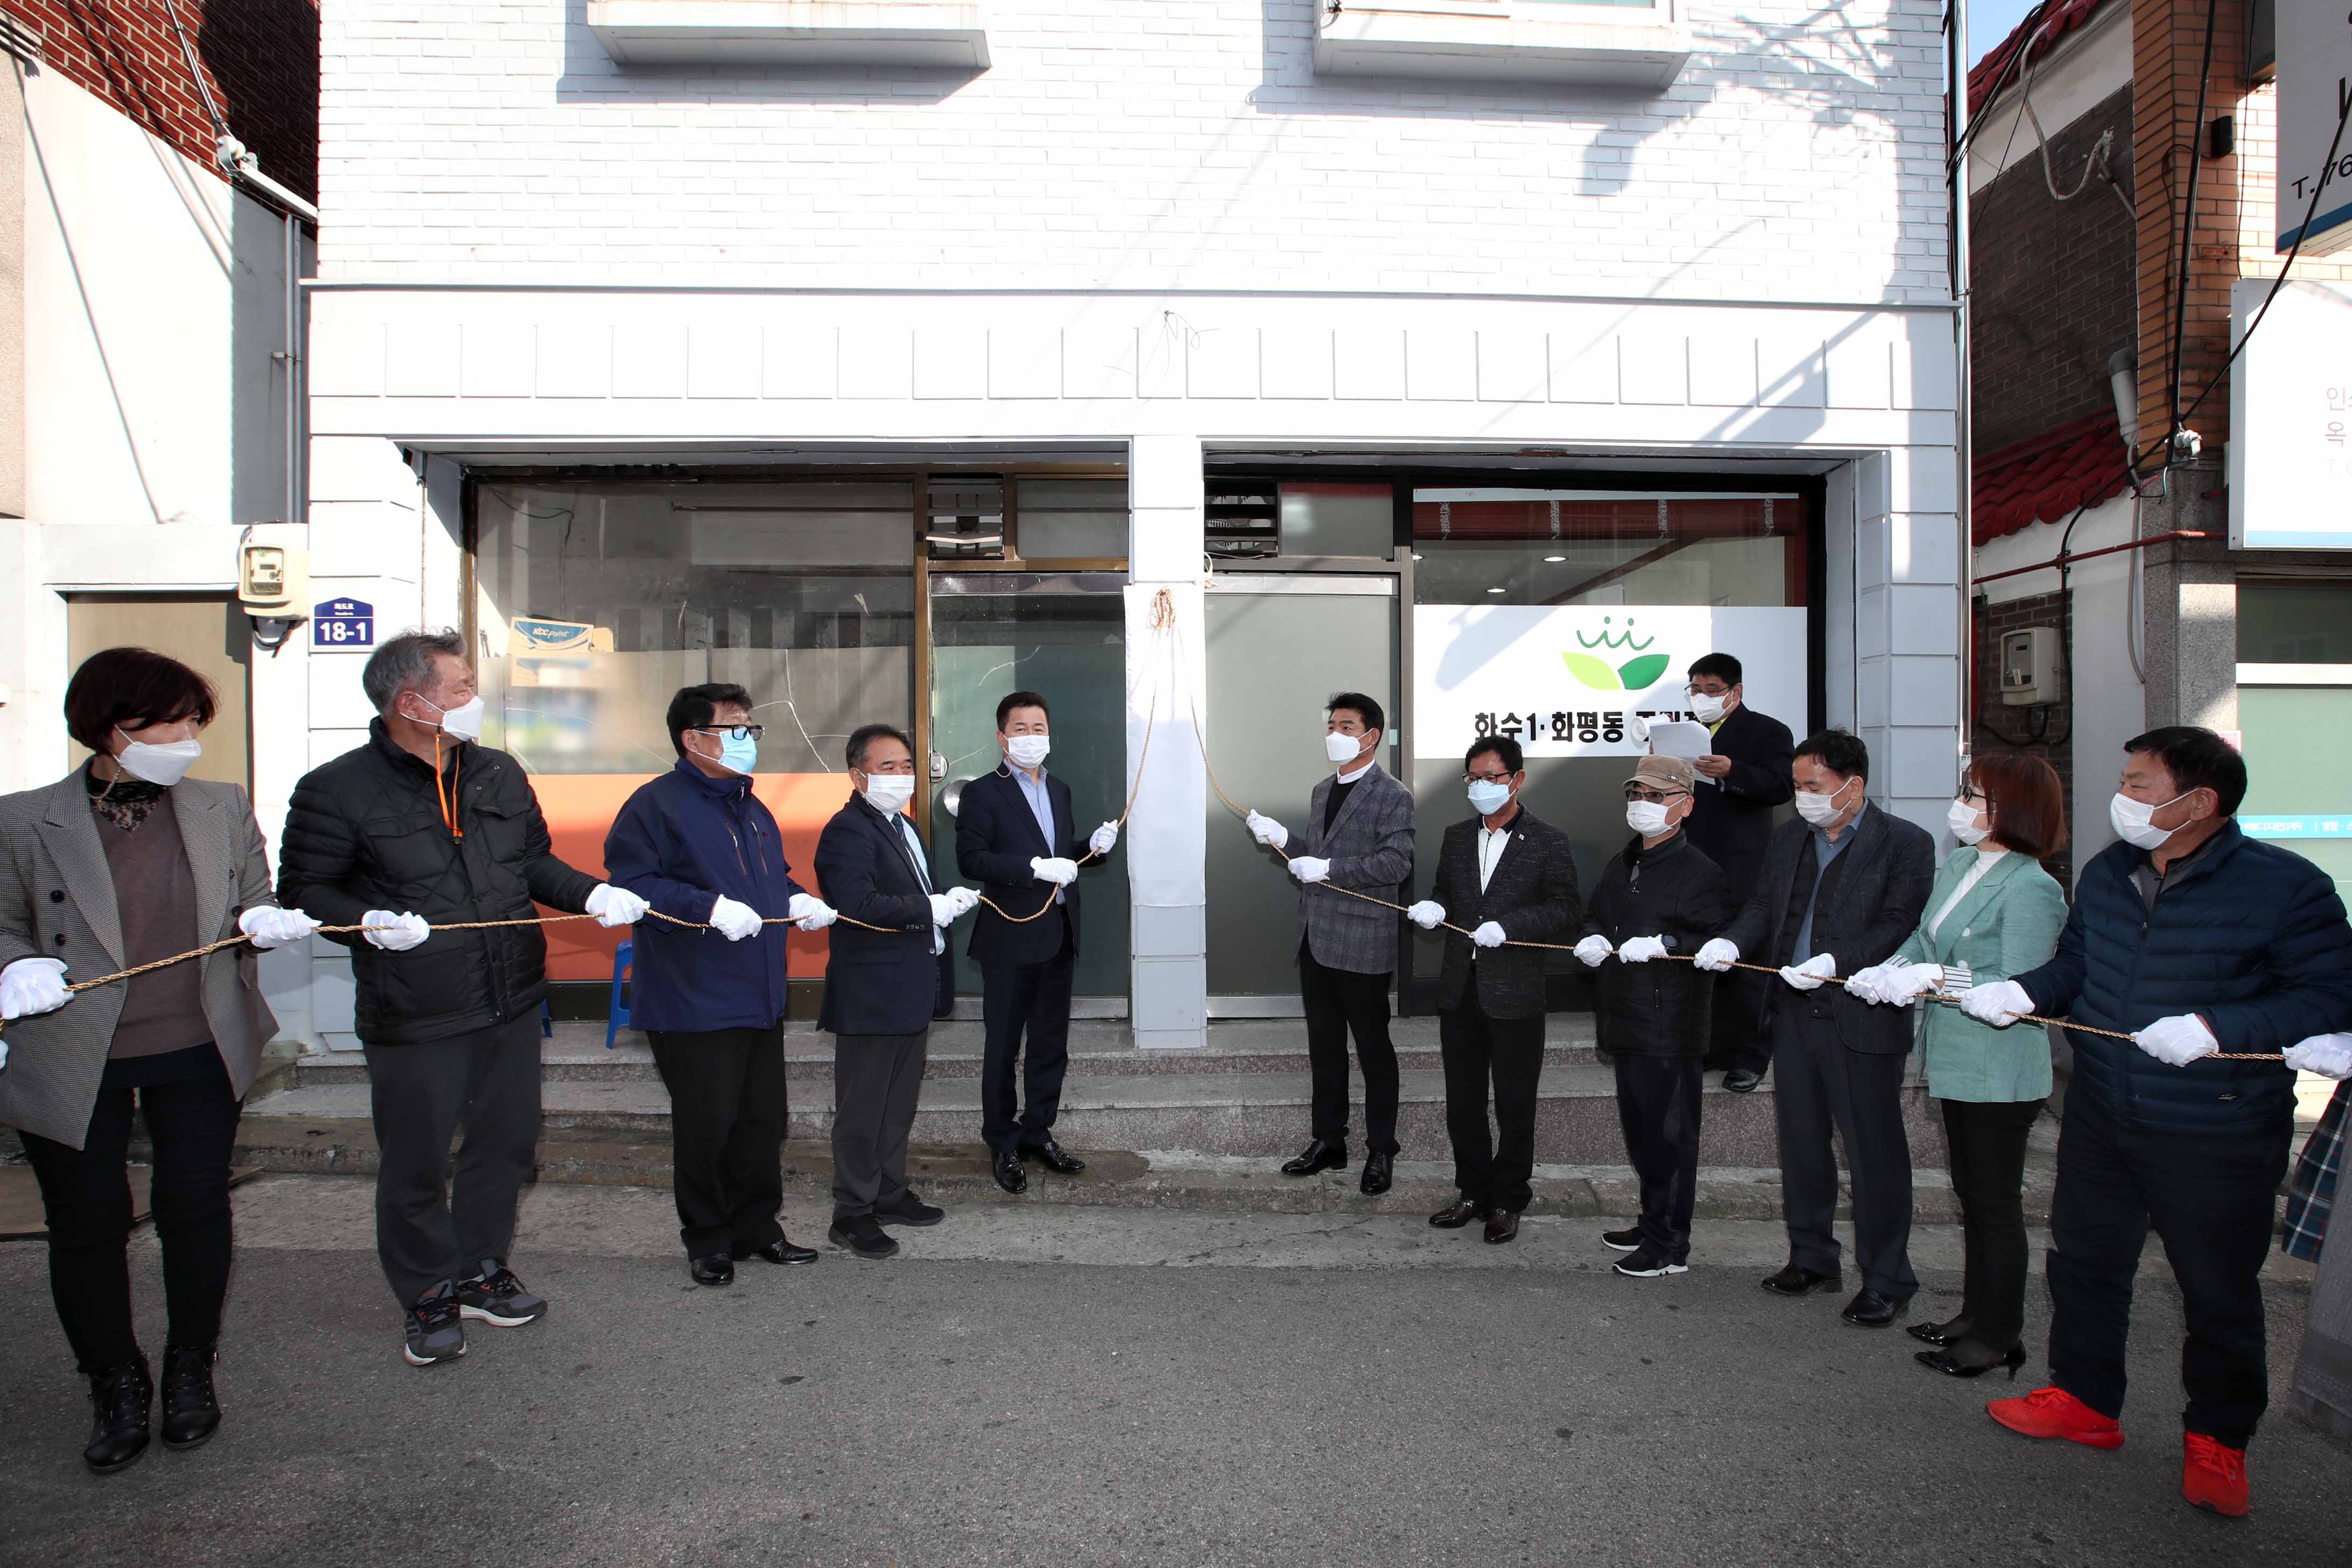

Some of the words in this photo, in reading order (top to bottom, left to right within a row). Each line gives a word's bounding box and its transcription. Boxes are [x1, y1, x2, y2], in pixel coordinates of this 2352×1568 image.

[2326, 387, 2352, 411] 인
[319, 622, 366, 641] 18-1
[1475, 711, 1624, 743] 화수1·화평동
